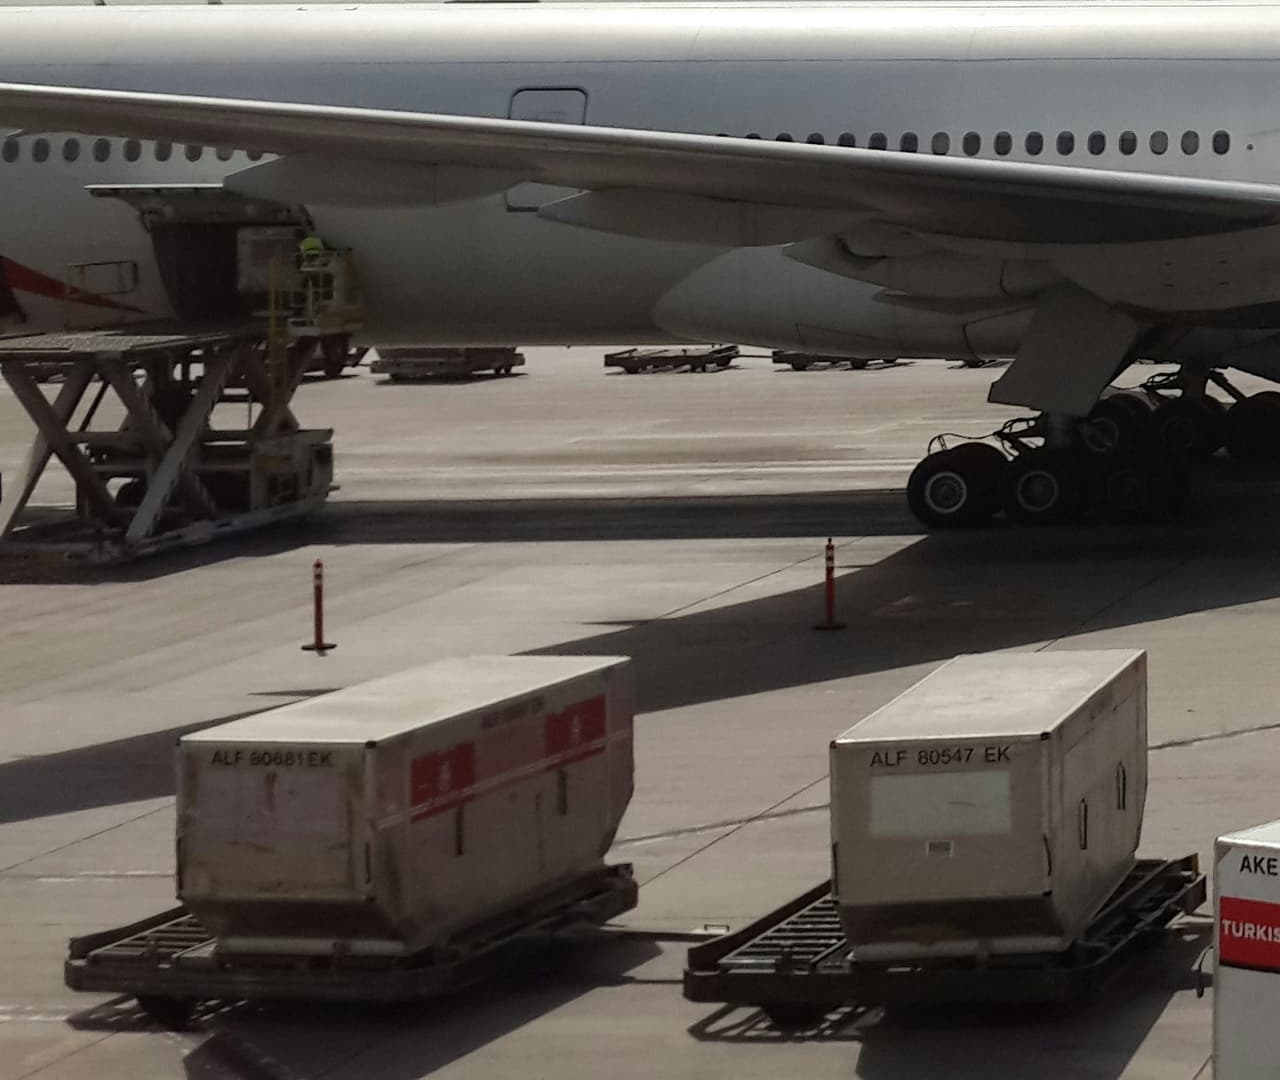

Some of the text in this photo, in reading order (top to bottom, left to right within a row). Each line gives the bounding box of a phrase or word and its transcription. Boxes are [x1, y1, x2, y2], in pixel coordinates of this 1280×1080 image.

[870, 746, 1010, 768] ALF 80547 EK
[1240, 855, 1278, 876] AKE
